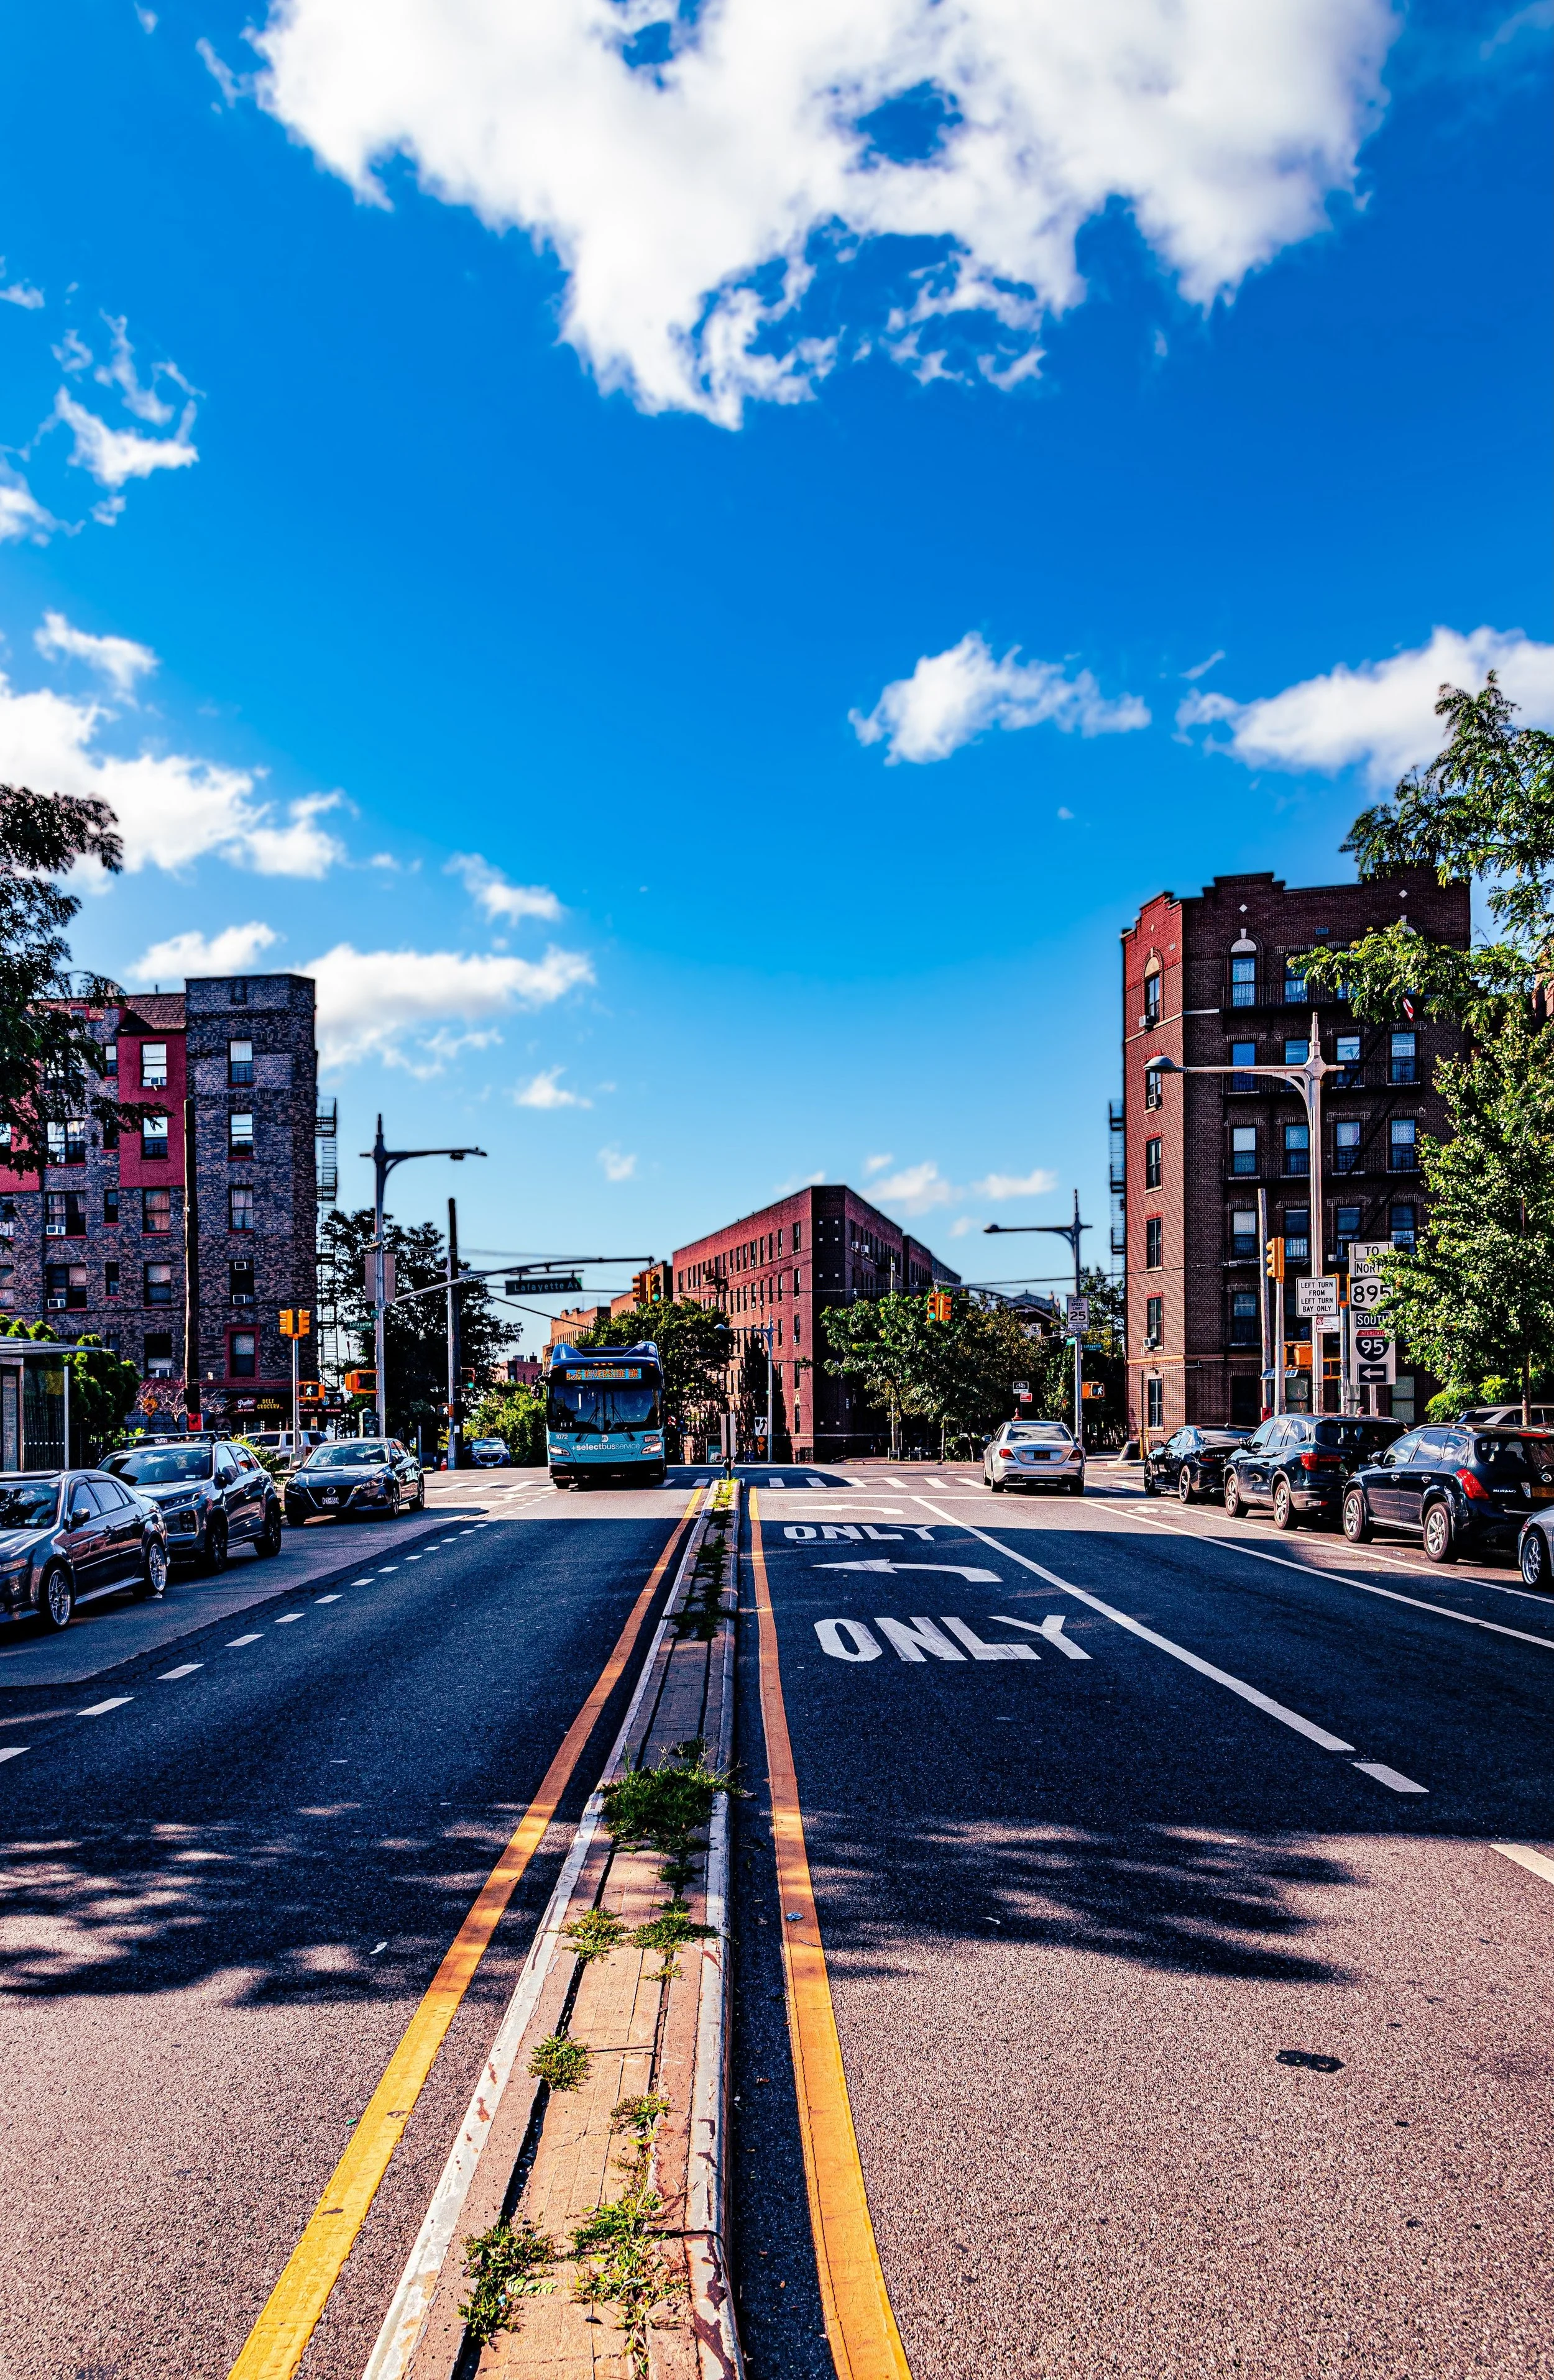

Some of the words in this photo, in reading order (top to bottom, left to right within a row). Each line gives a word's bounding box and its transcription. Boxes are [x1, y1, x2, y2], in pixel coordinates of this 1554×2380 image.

[1364, 1246, 1379, 1256] TO
[1356, 1263, 1384, 1273] NORT
[514, 1282, 564, 1292] Lafayette
[1353, 1284, 1392, 1303] 895
[1070, 1311, 1086, 1320] 25
[1361, 1339, 1384, 1355] 95
[584, 1368, 626, 1379] RIVERSIDE
[628, 1368, 639, 1378] DR
[784, 1526, 935, 1540] ONLY
[814, 1615, 1093, 1662] ONLY
